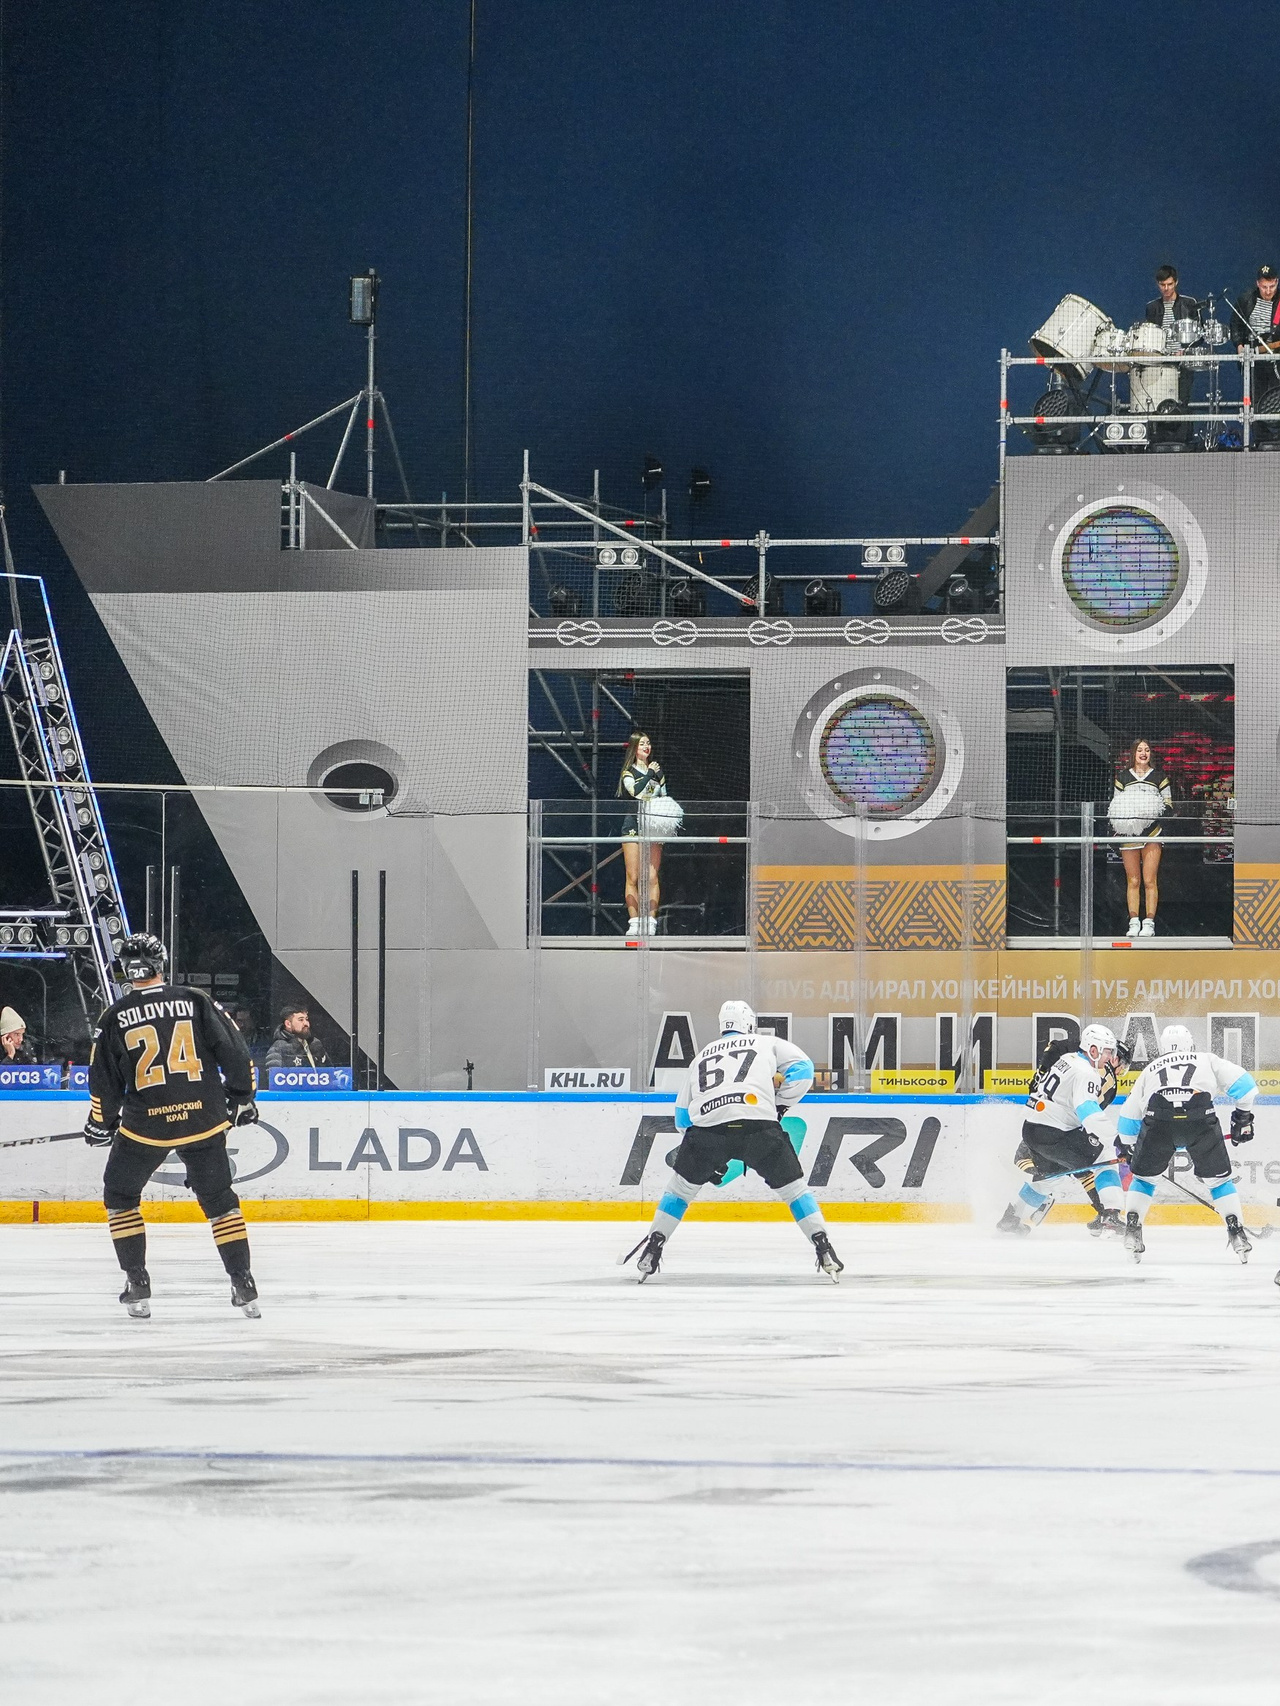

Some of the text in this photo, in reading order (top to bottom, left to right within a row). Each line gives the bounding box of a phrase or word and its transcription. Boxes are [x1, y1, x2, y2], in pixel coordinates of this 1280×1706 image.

[133, 967, 146, 978] 24
[1134, 979, 1242, 1001] АДМИРАЛ
[117, 1000, 194, 1028] SOLOVYOV
[725, 1021, 734, 1029] 67
[124, 1019, 203, 1091] 24
[702, 1038, 756, 1058] BORIKOV
[698, 1049, 758, 1093] 67
[1150, 1053, 1198, 1073] OSNOVIN
[274, 1073, 330, 1086] согаз
[549, 1072, 625, 1088] KHL.RU
[878, 1077, 948, 1087] ТИНЬКОФФ
[991, 1078, 1031, 1087] ТИНЬК
[1155, 1063, 1197, 1087] 17
[148, 1100, 202, 1116] ПРИМОРСКИЙ
[702, 1095, 742, 1113] Winline
[166, 1111, 189, 1123] КРАЙ
[308, 1127, 490, 1172] LADA
